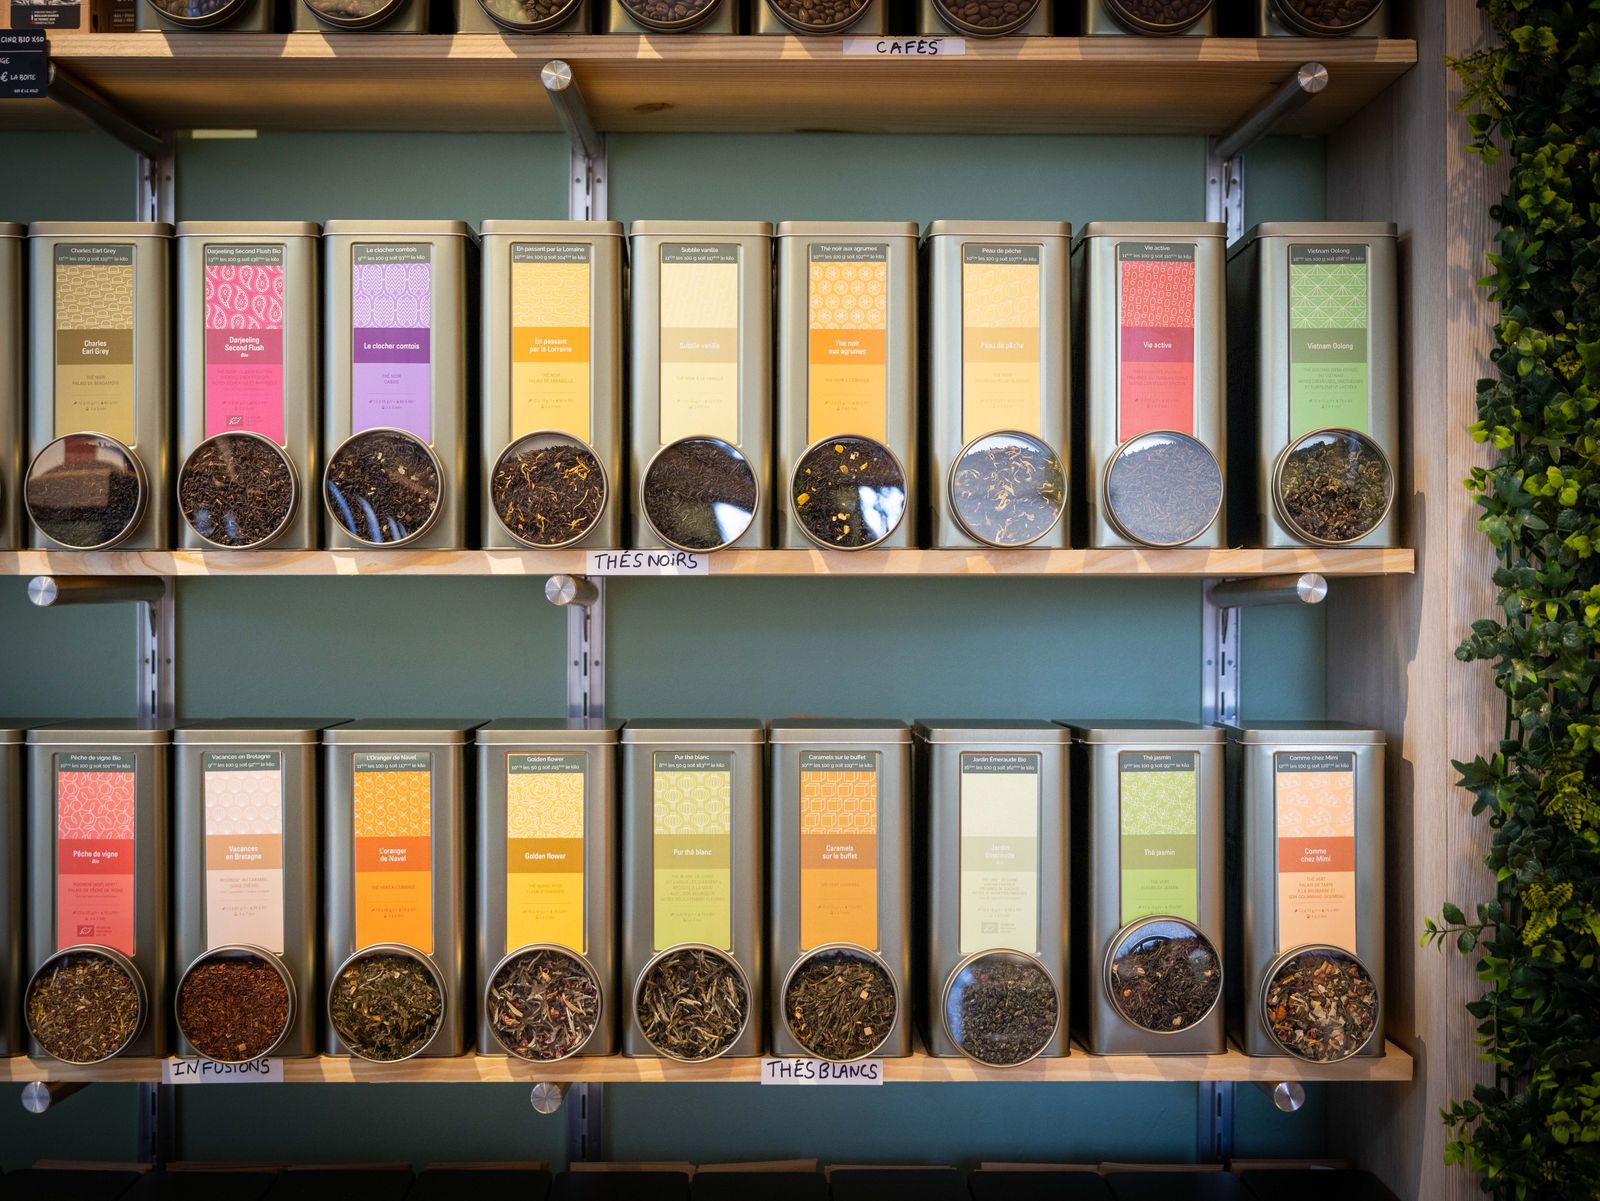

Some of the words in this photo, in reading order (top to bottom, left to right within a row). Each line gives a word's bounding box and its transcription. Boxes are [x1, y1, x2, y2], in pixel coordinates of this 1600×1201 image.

[876, 40, 938, 55] CAFÉS
[595, 551, 644, 570] THÉS
[172, 1059, 270, 1076] INFUSIONS
[767, 1059, 815, 1079] THÉS
[819, 1062, 878, 1079] BLANCS
